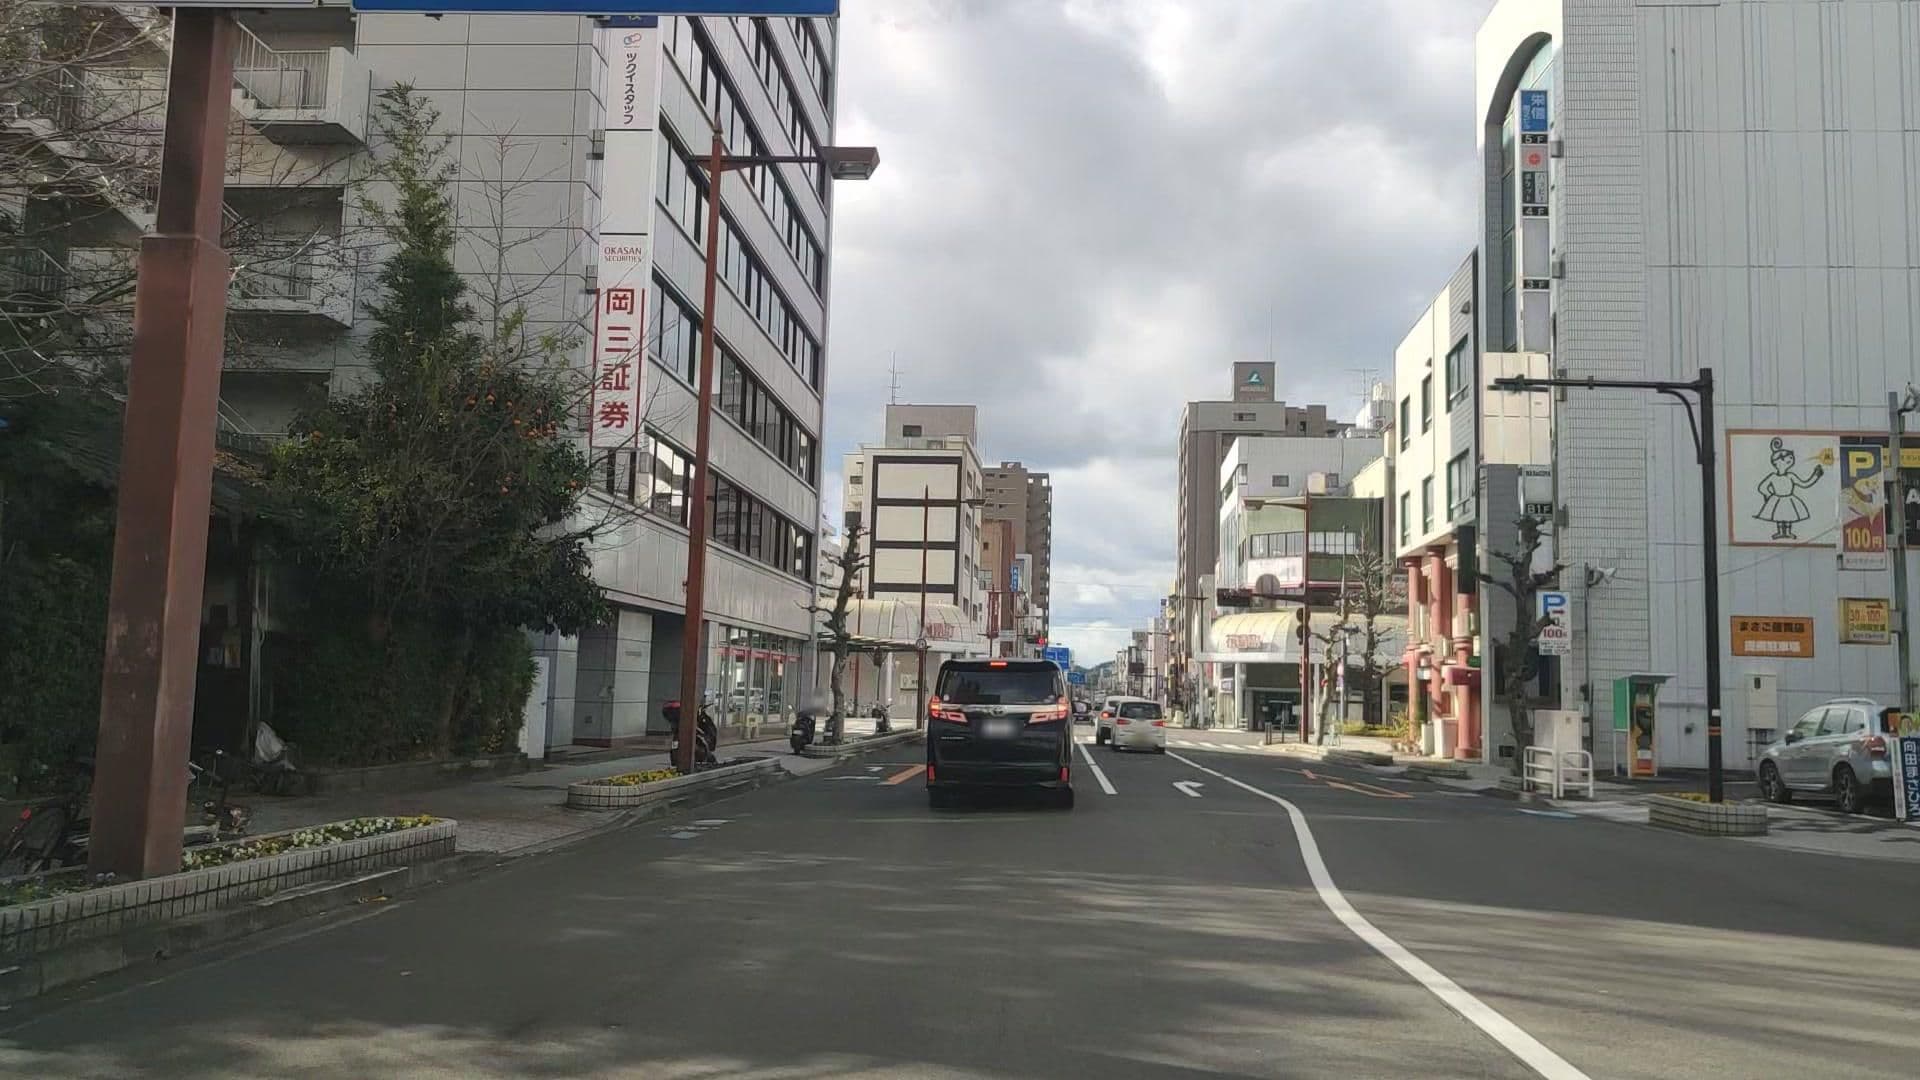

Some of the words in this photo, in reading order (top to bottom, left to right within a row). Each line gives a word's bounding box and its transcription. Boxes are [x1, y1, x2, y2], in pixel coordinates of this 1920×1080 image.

[624, 52, 637, 125] ツクイスタッフ
[604, 246, 642, 255] OKASAN
[600, 288, 635, 429] 岡三証券
[1848, 451, 1874, 478] P
[1527, 504, 1552, 514] B1F
[1543, 594, 1566, 616] P
